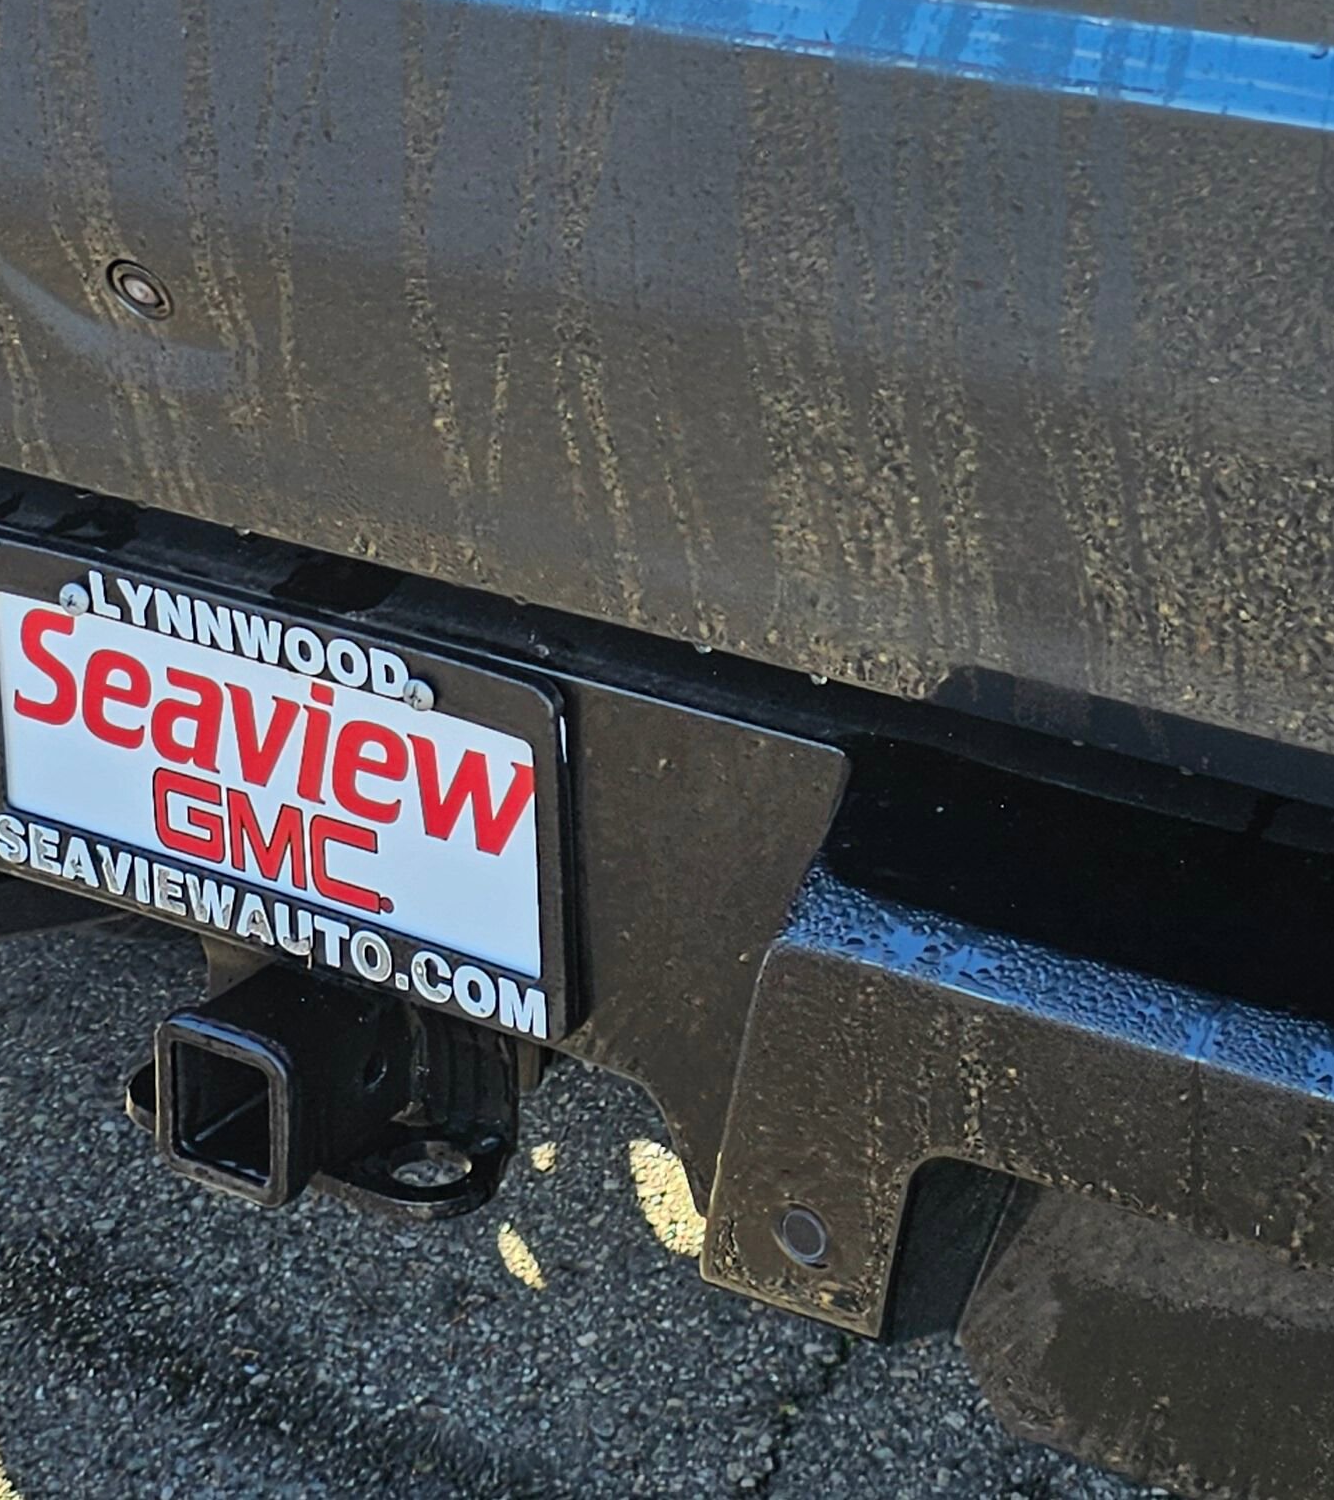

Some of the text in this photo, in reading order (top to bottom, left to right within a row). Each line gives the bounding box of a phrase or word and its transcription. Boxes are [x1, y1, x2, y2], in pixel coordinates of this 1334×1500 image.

[88, 570, 410, 700] LYNNWOOD
[14, 608, 535, 856] Seaview
[153, 767, 394, 915] GMC
